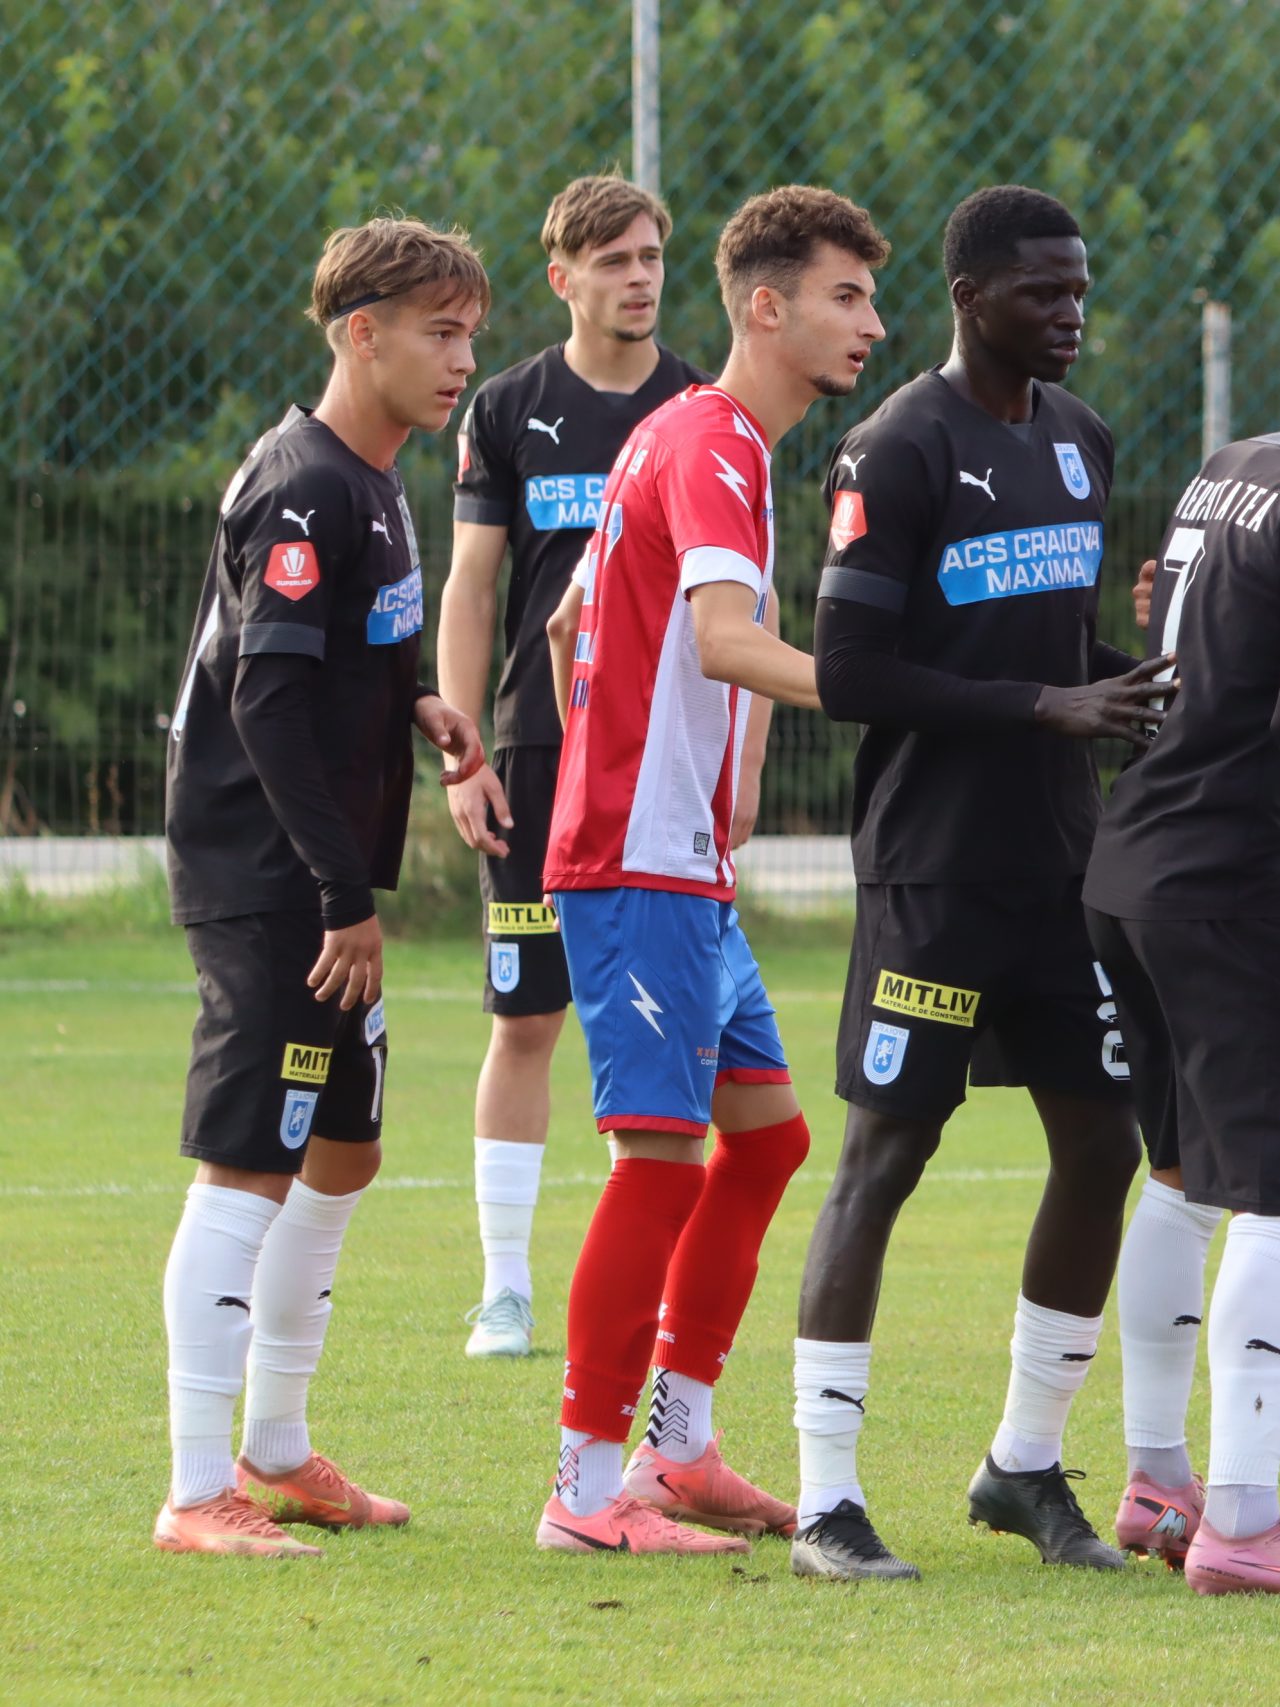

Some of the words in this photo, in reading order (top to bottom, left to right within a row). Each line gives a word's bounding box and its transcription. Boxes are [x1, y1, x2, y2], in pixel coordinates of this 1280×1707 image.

[528, 478, 575, 502] ACS
[558, 502, 600, 523] MA
[943, 537, 1007, 574] ACS
[1013, 525, 1100, 560] CRAIOVA
[986, 557, 1086, 593] MAXIMA
[1144, 527, 1206, 739] 7
[881, 998, 916, 1012] MATERIALE
[882, 975, 975, 1014] MITLIV
[290, 1048, 330, 1071] MIT
